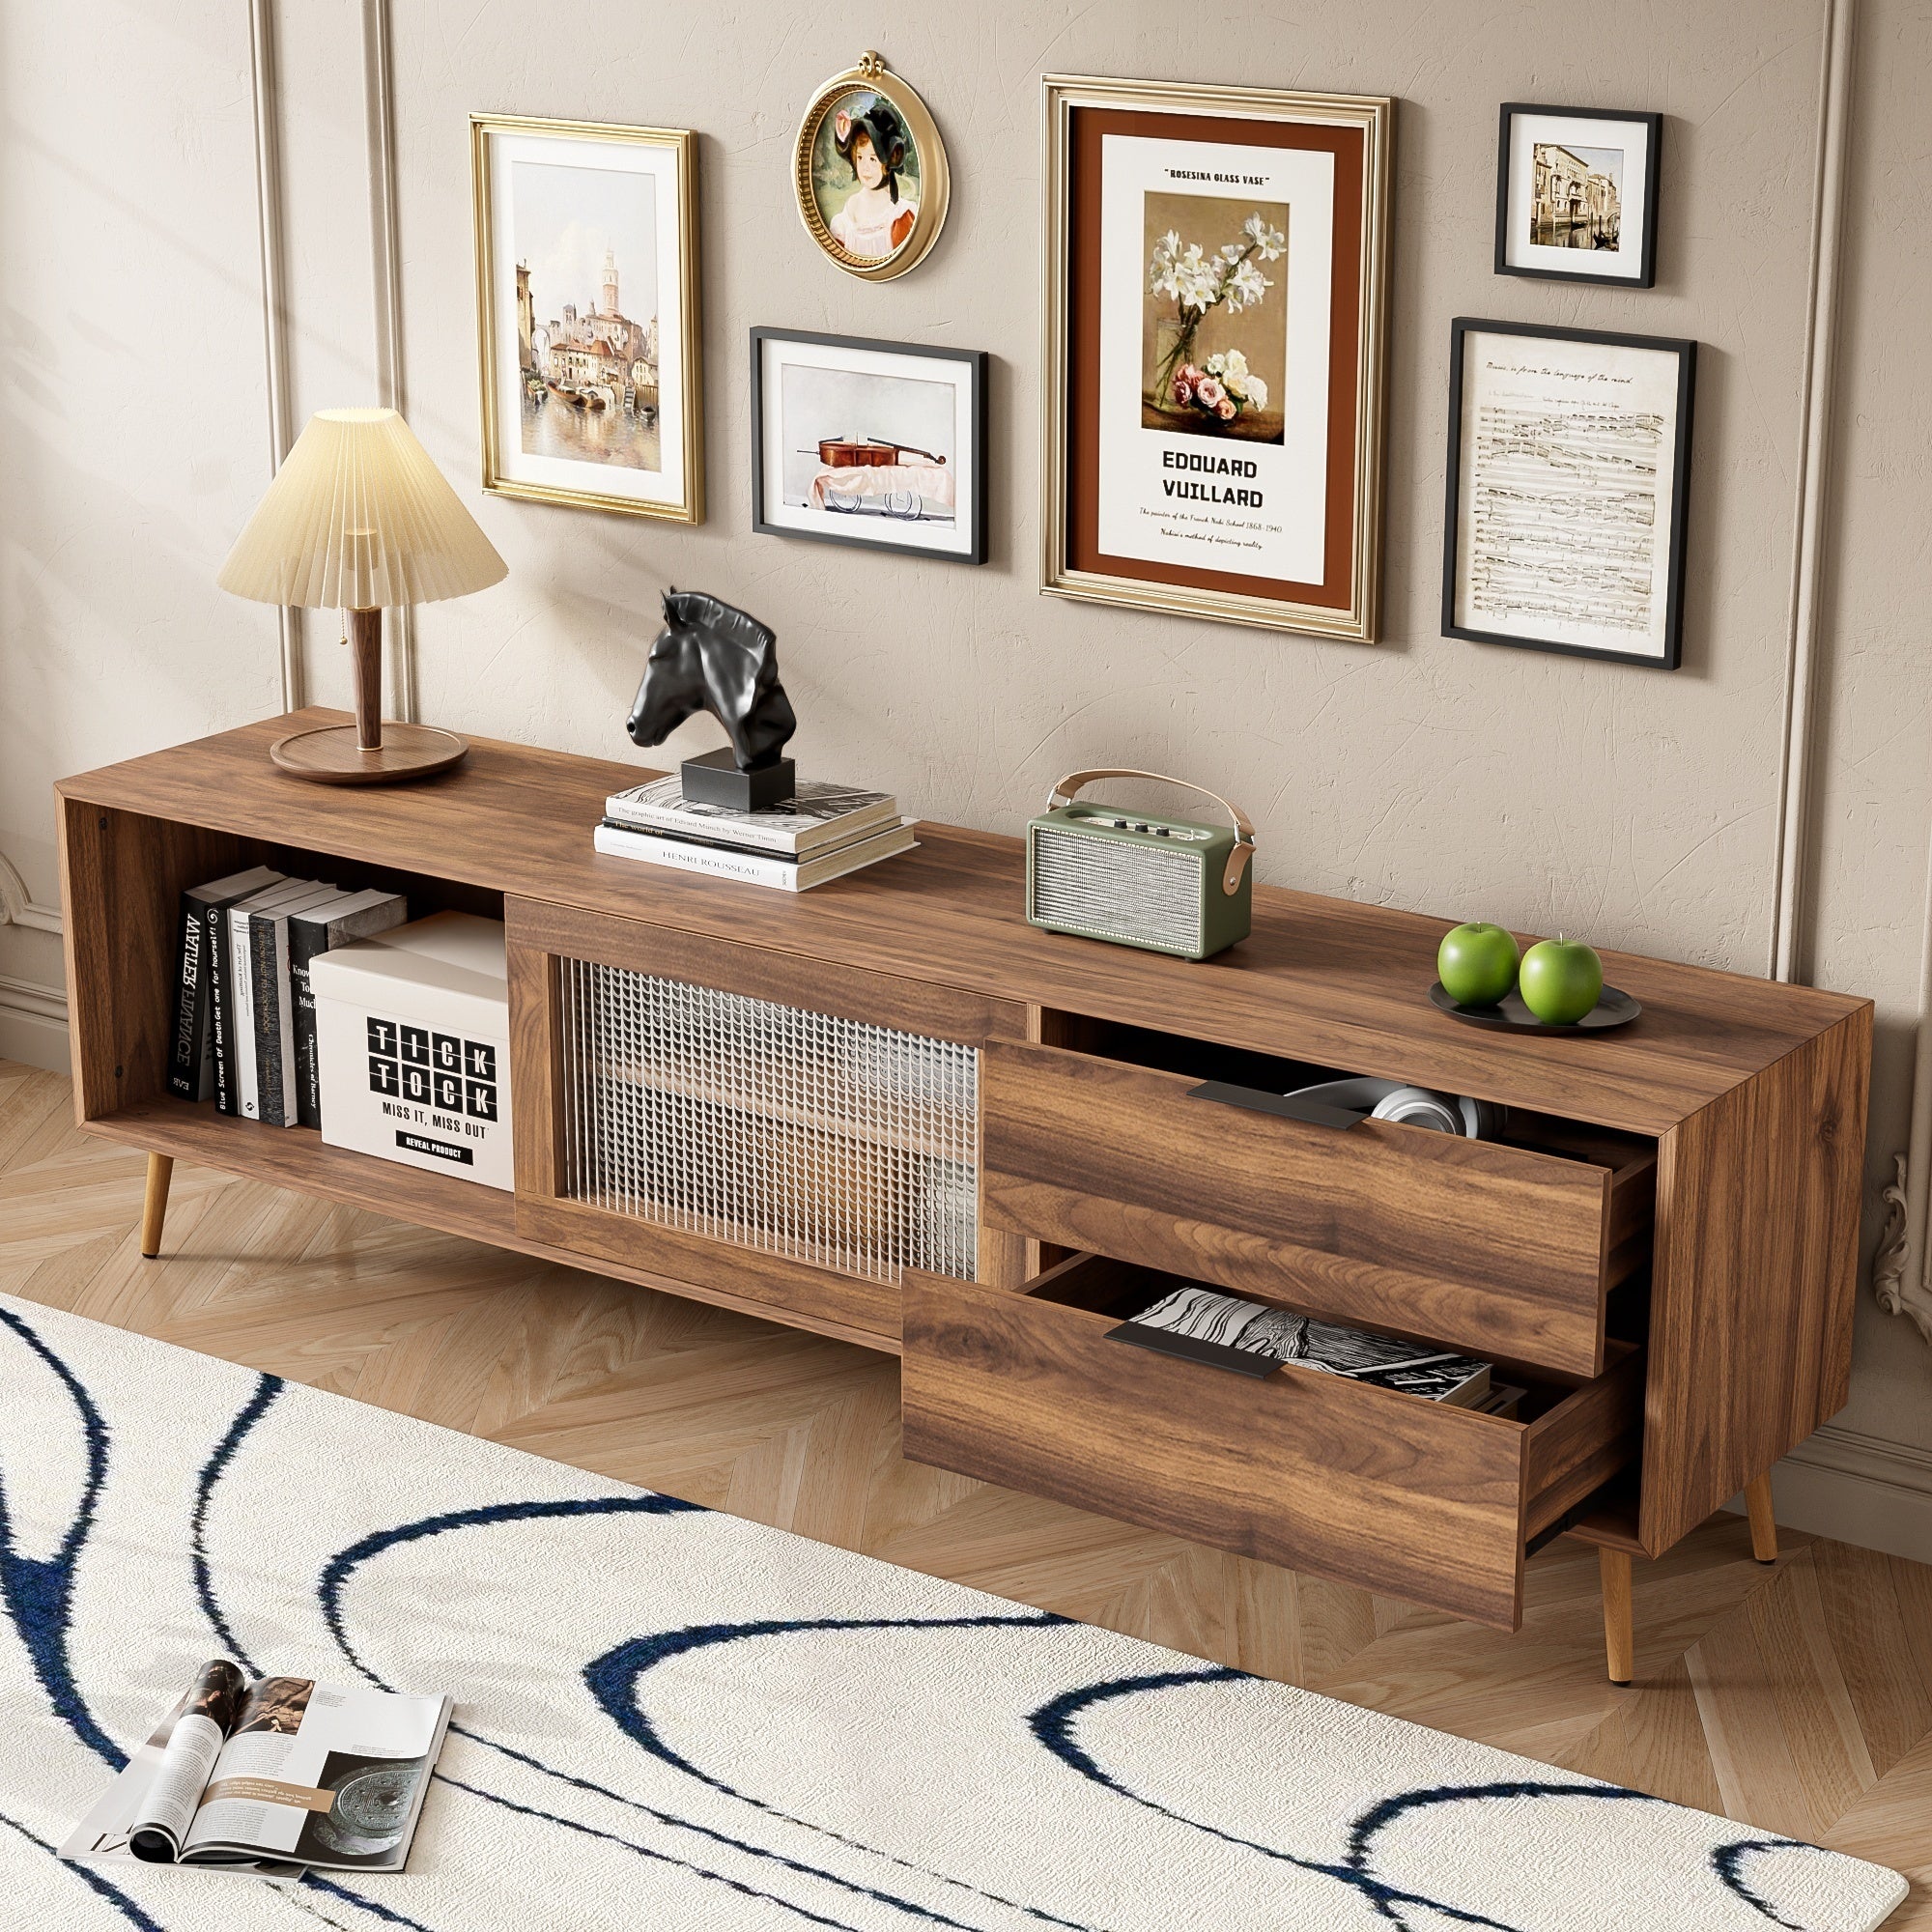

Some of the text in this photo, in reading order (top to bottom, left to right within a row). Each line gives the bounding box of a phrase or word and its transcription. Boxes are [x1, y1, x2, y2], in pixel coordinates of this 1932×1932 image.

[1213, 173, 1240, 184] GLASS
[1516, 365, 1538, 375] from
[1587, 373, 1598, 383] of
[1162, 450, 1258, 479] EDOUARD
[1162, 479, 1264, 509] VUILLARD
[1171, 512, 1179, 521] of
[1189, 514, 1209, 523] French
[1225, 519, 1245, 527] School
[1184, 532, 1207, 541] method
[1207, 534, 1214, 544] of
[1242, 541, 1263, 550] reality
[631, 810, 654, 819] graphic
[697, 822, 722, 831] Munch
[722, 826, 730, 835] by
[731, 829, 755, 838] Werner
[631, 825, 653, 834] world
[662, 851, 760, 876] HENRI ROUSSEAU
[214, 1022, 223, 1045] Death
[375, 1025, 488, 1075] TICK
[377, 1063, 489, 1114] TOCK
[382, 1101, 487, 1140] MISS IT, MISS OUT
[406, 1136, 462, 1159] REVEAL PRODUCT
